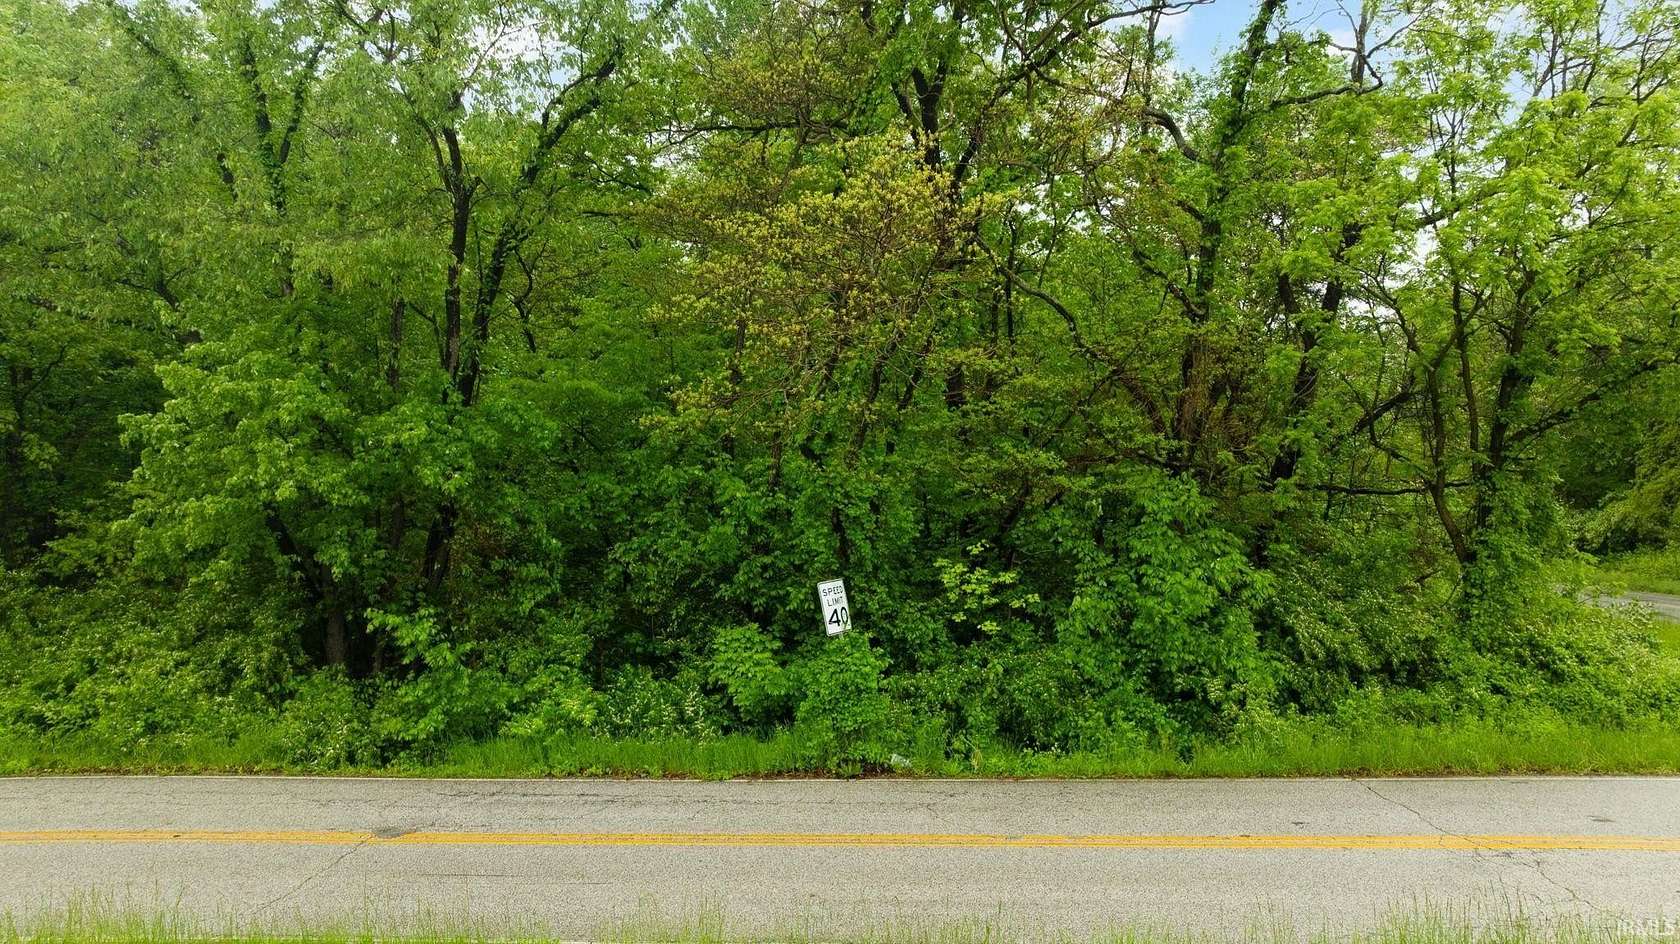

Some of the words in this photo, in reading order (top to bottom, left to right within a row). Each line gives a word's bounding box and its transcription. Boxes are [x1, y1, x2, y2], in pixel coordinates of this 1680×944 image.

[823, 586, 843, 597] SPEED
[827, 596, 844, 607] LIMIT
[828, 607, 848, 626] 40
